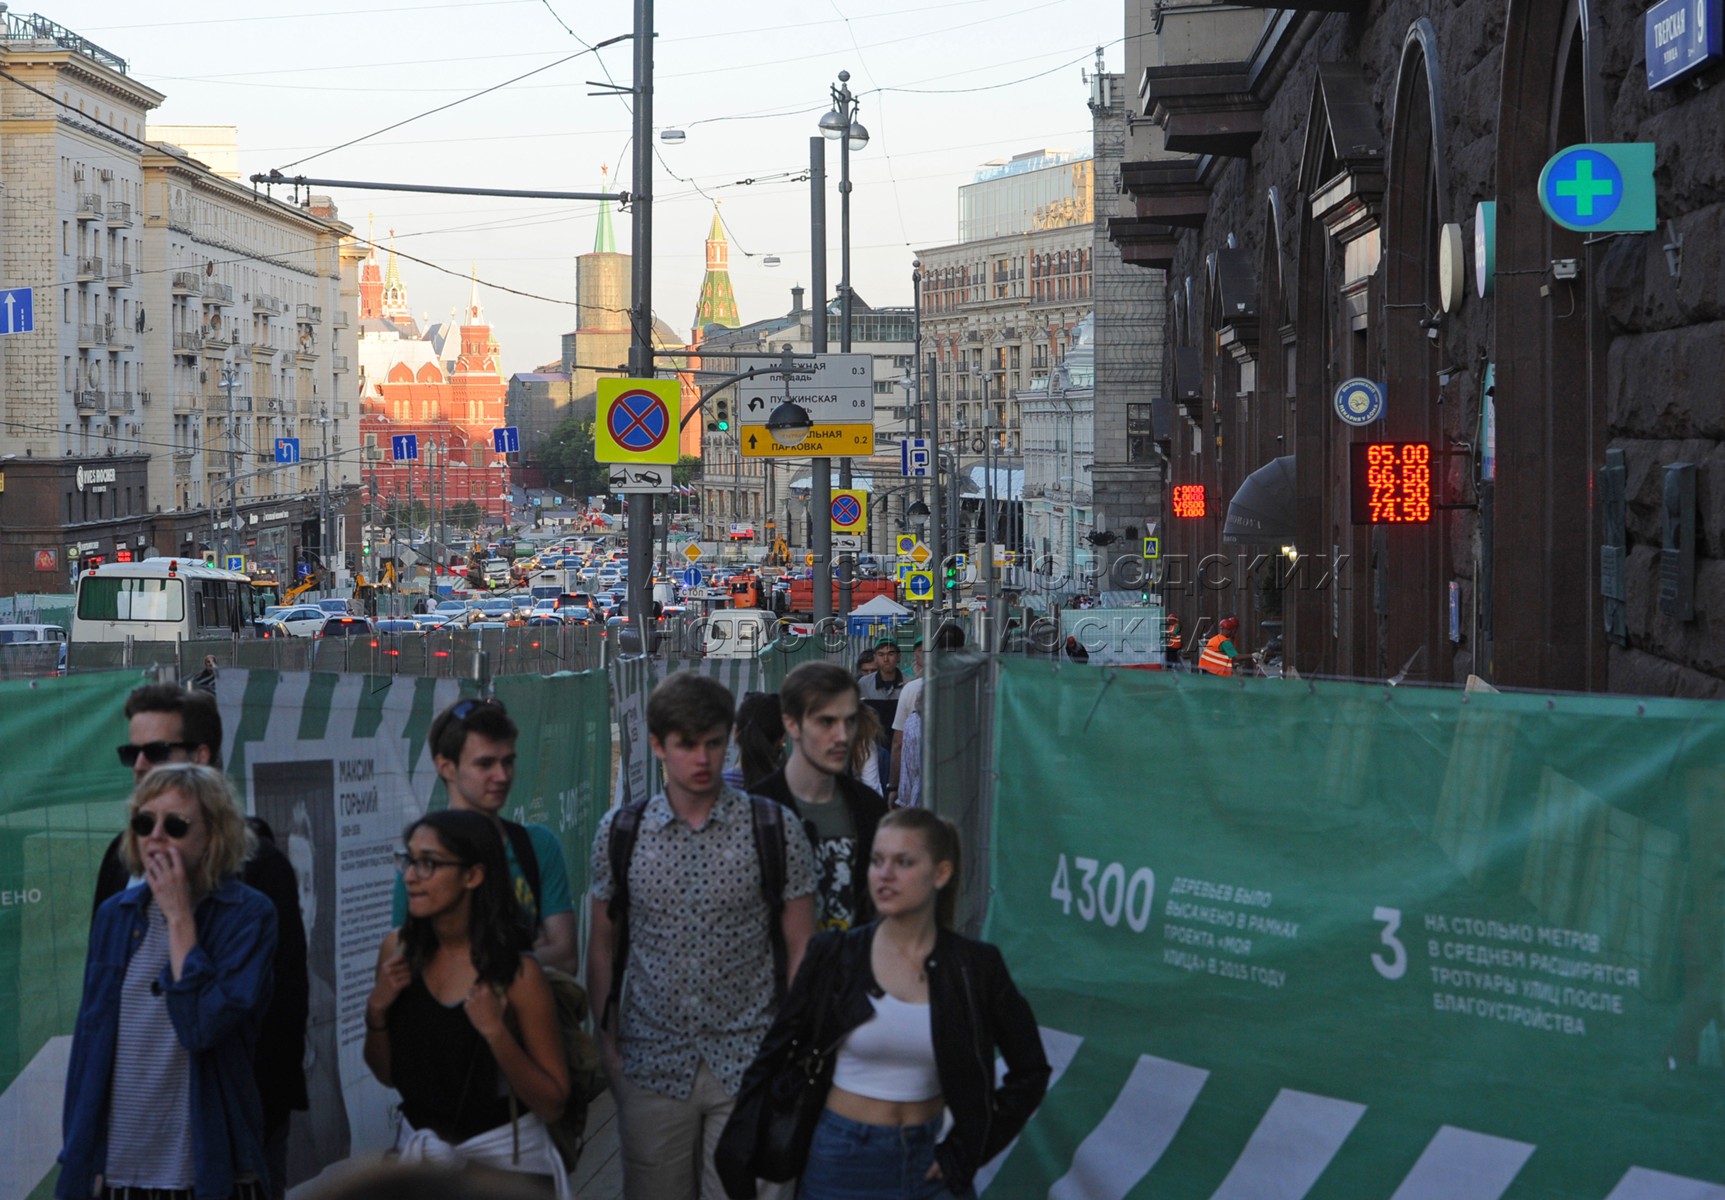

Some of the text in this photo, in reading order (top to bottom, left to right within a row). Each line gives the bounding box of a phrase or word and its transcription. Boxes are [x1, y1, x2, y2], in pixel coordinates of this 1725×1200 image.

[1654, 8, 1685, 48] ТВЕРСКАЯ
[1697, 0, 1704, 43] 9
[770, 362, 826, 371] МЕЖНАЯ
[852, 367, 865, 375] 0.3
[852, 400, 866, 408] 0.8
[854, 436, 868, 444] 0.2
[1368, 445, 1429, 465] 65.00
[1368, 465, 1429, 484] 66.50
[1368, 484, 1429, 502] 72.50
[1368, 502, 1429, 522] 74.50
[1050, 853, 1155, 933] 4300
[1169, 877, 1272, 909] ДЕРЕВЬЕВ БЫЛО
[1165, 900, 1299, 940] ВЫСАЖЕНО В РАМКАХ
[1424, 914, 1600, 954] НА СТОЛЬКО МЕТРОВ
[1164, 924, 1214, 948] ПРОЕКТА
[1371, 906, 1408, 980] 3
[1207, 958, 1217, 974] В
[1219, 959, 1248, 980] 2015
[1250, 965, 1286, 988] ГОДУ
[1428, 939, 1640, 988] В СРЕДНЕМ РАСШИРЯТСЯ
[1430, 965, 1624, 1015] ТРОТУАРЫ УЛИЦ ПОСЛЕ
[1433, 992, 1586, 1036] БЛАГОУСТРОЙСТВА
